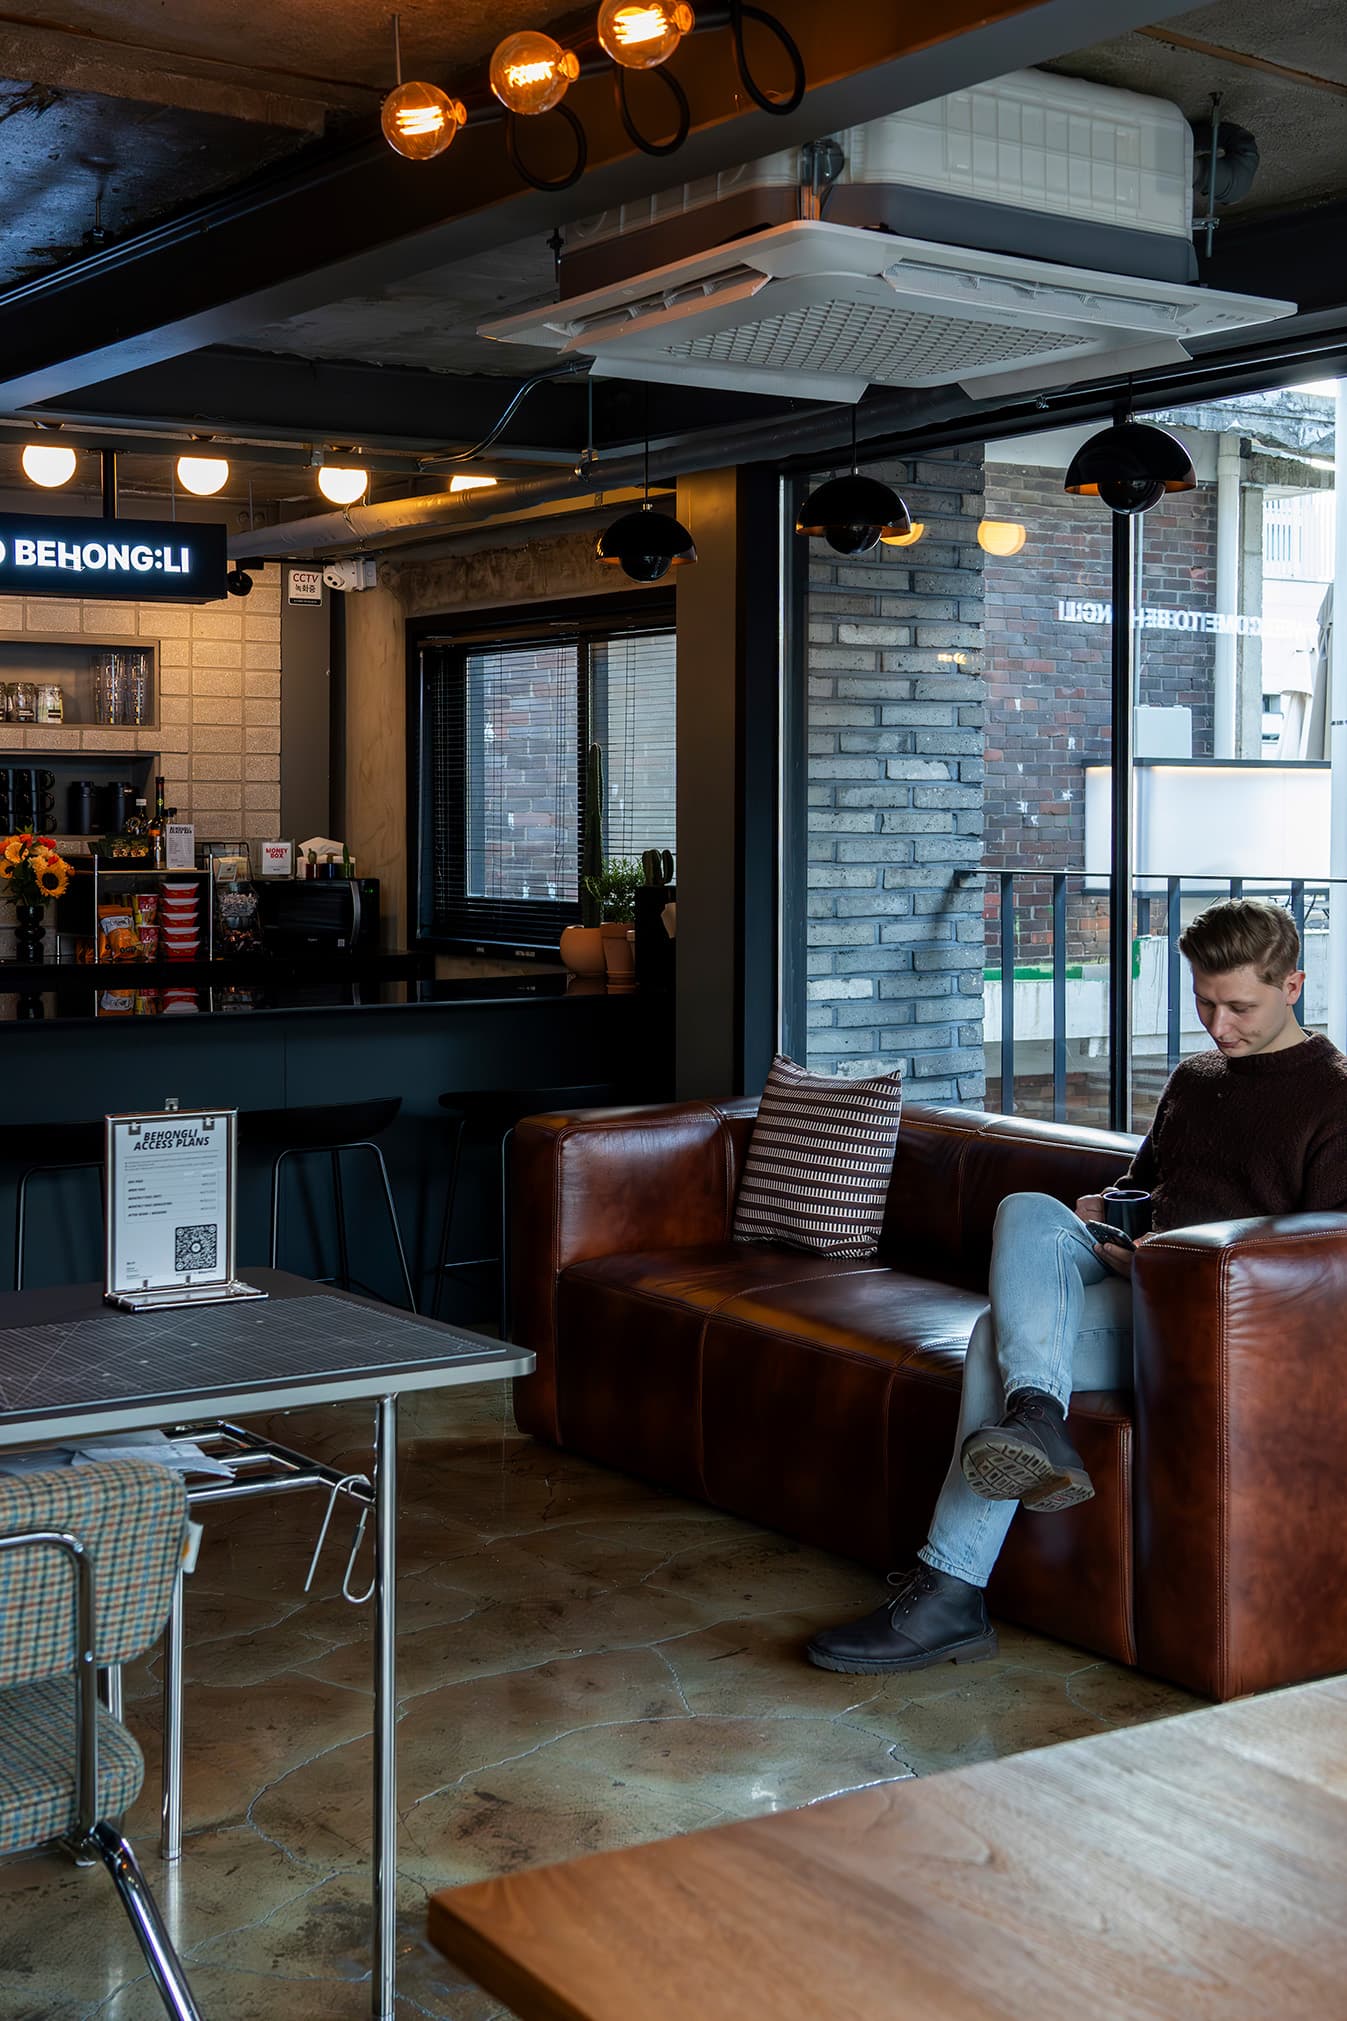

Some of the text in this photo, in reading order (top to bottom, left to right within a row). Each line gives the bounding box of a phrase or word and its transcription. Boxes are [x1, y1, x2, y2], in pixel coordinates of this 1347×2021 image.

[14, 538, 190, 574] BEHONG:LI
[293, 573, 319, 583] CCTV
[143, 1128, 198, 1141] BEHONGLI
[133, 1136, 210, 1151] ACCESS PLANS
